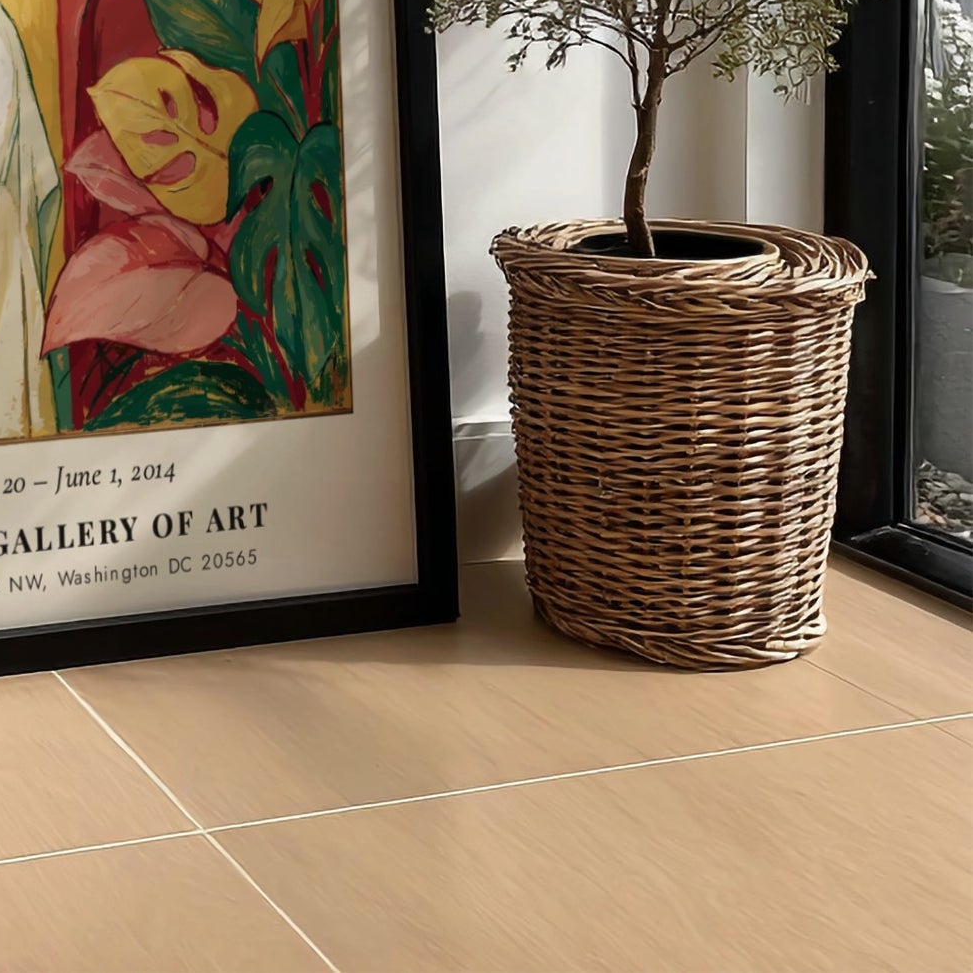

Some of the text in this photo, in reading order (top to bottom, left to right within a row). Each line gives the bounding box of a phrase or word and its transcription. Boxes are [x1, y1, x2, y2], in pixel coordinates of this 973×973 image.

[2, 476, 26, 495] 20
[54, 465, 102, 495] June
[109, 467, 123, 489] 1,
[130, 462, 176, 484] 2014
[151, 510, 194, 539] OF
[205, 502, 268, 534] ART
[9, 572, 47, 593] NW,
[57, 564, 158, 587] Washington
[168, 556, 192, 575] DC
[201, 548, 257, 571] 20565
